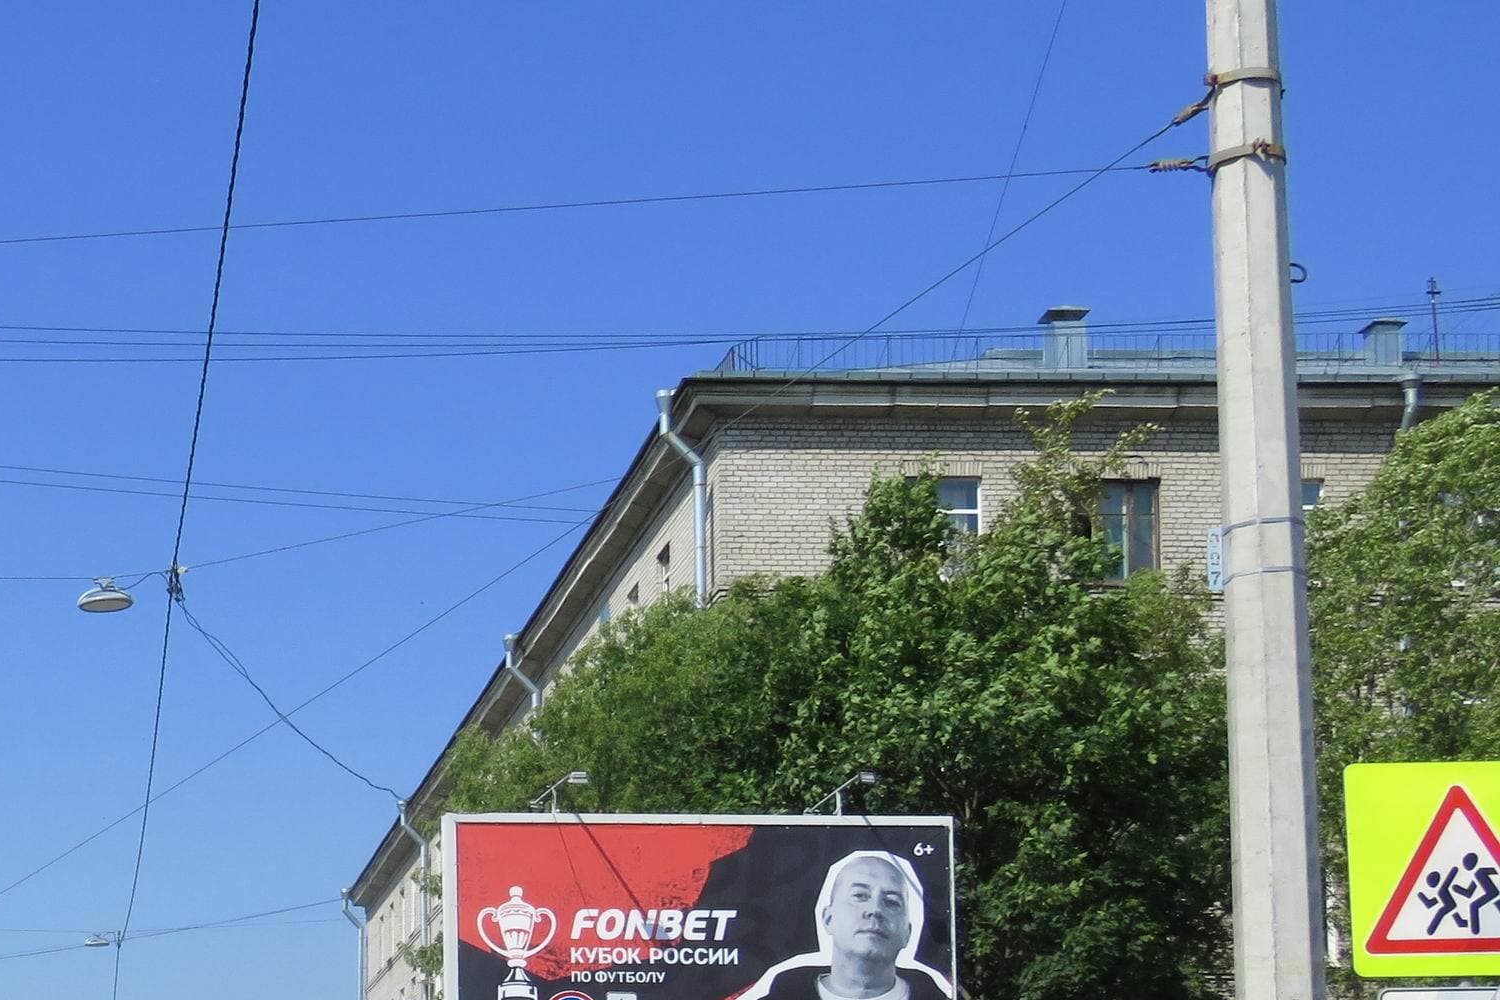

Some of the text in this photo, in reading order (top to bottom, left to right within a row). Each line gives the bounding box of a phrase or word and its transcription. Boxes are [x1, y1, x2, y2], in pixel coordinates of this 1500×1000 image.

[913, 842, 935, 856] 6+
[570, 908, 738, 941] FONBET
[570, 947, 739, 965] КУБОК РОССИИ
[571, 970, 666, 984] ПО ФУТБОЛУ
